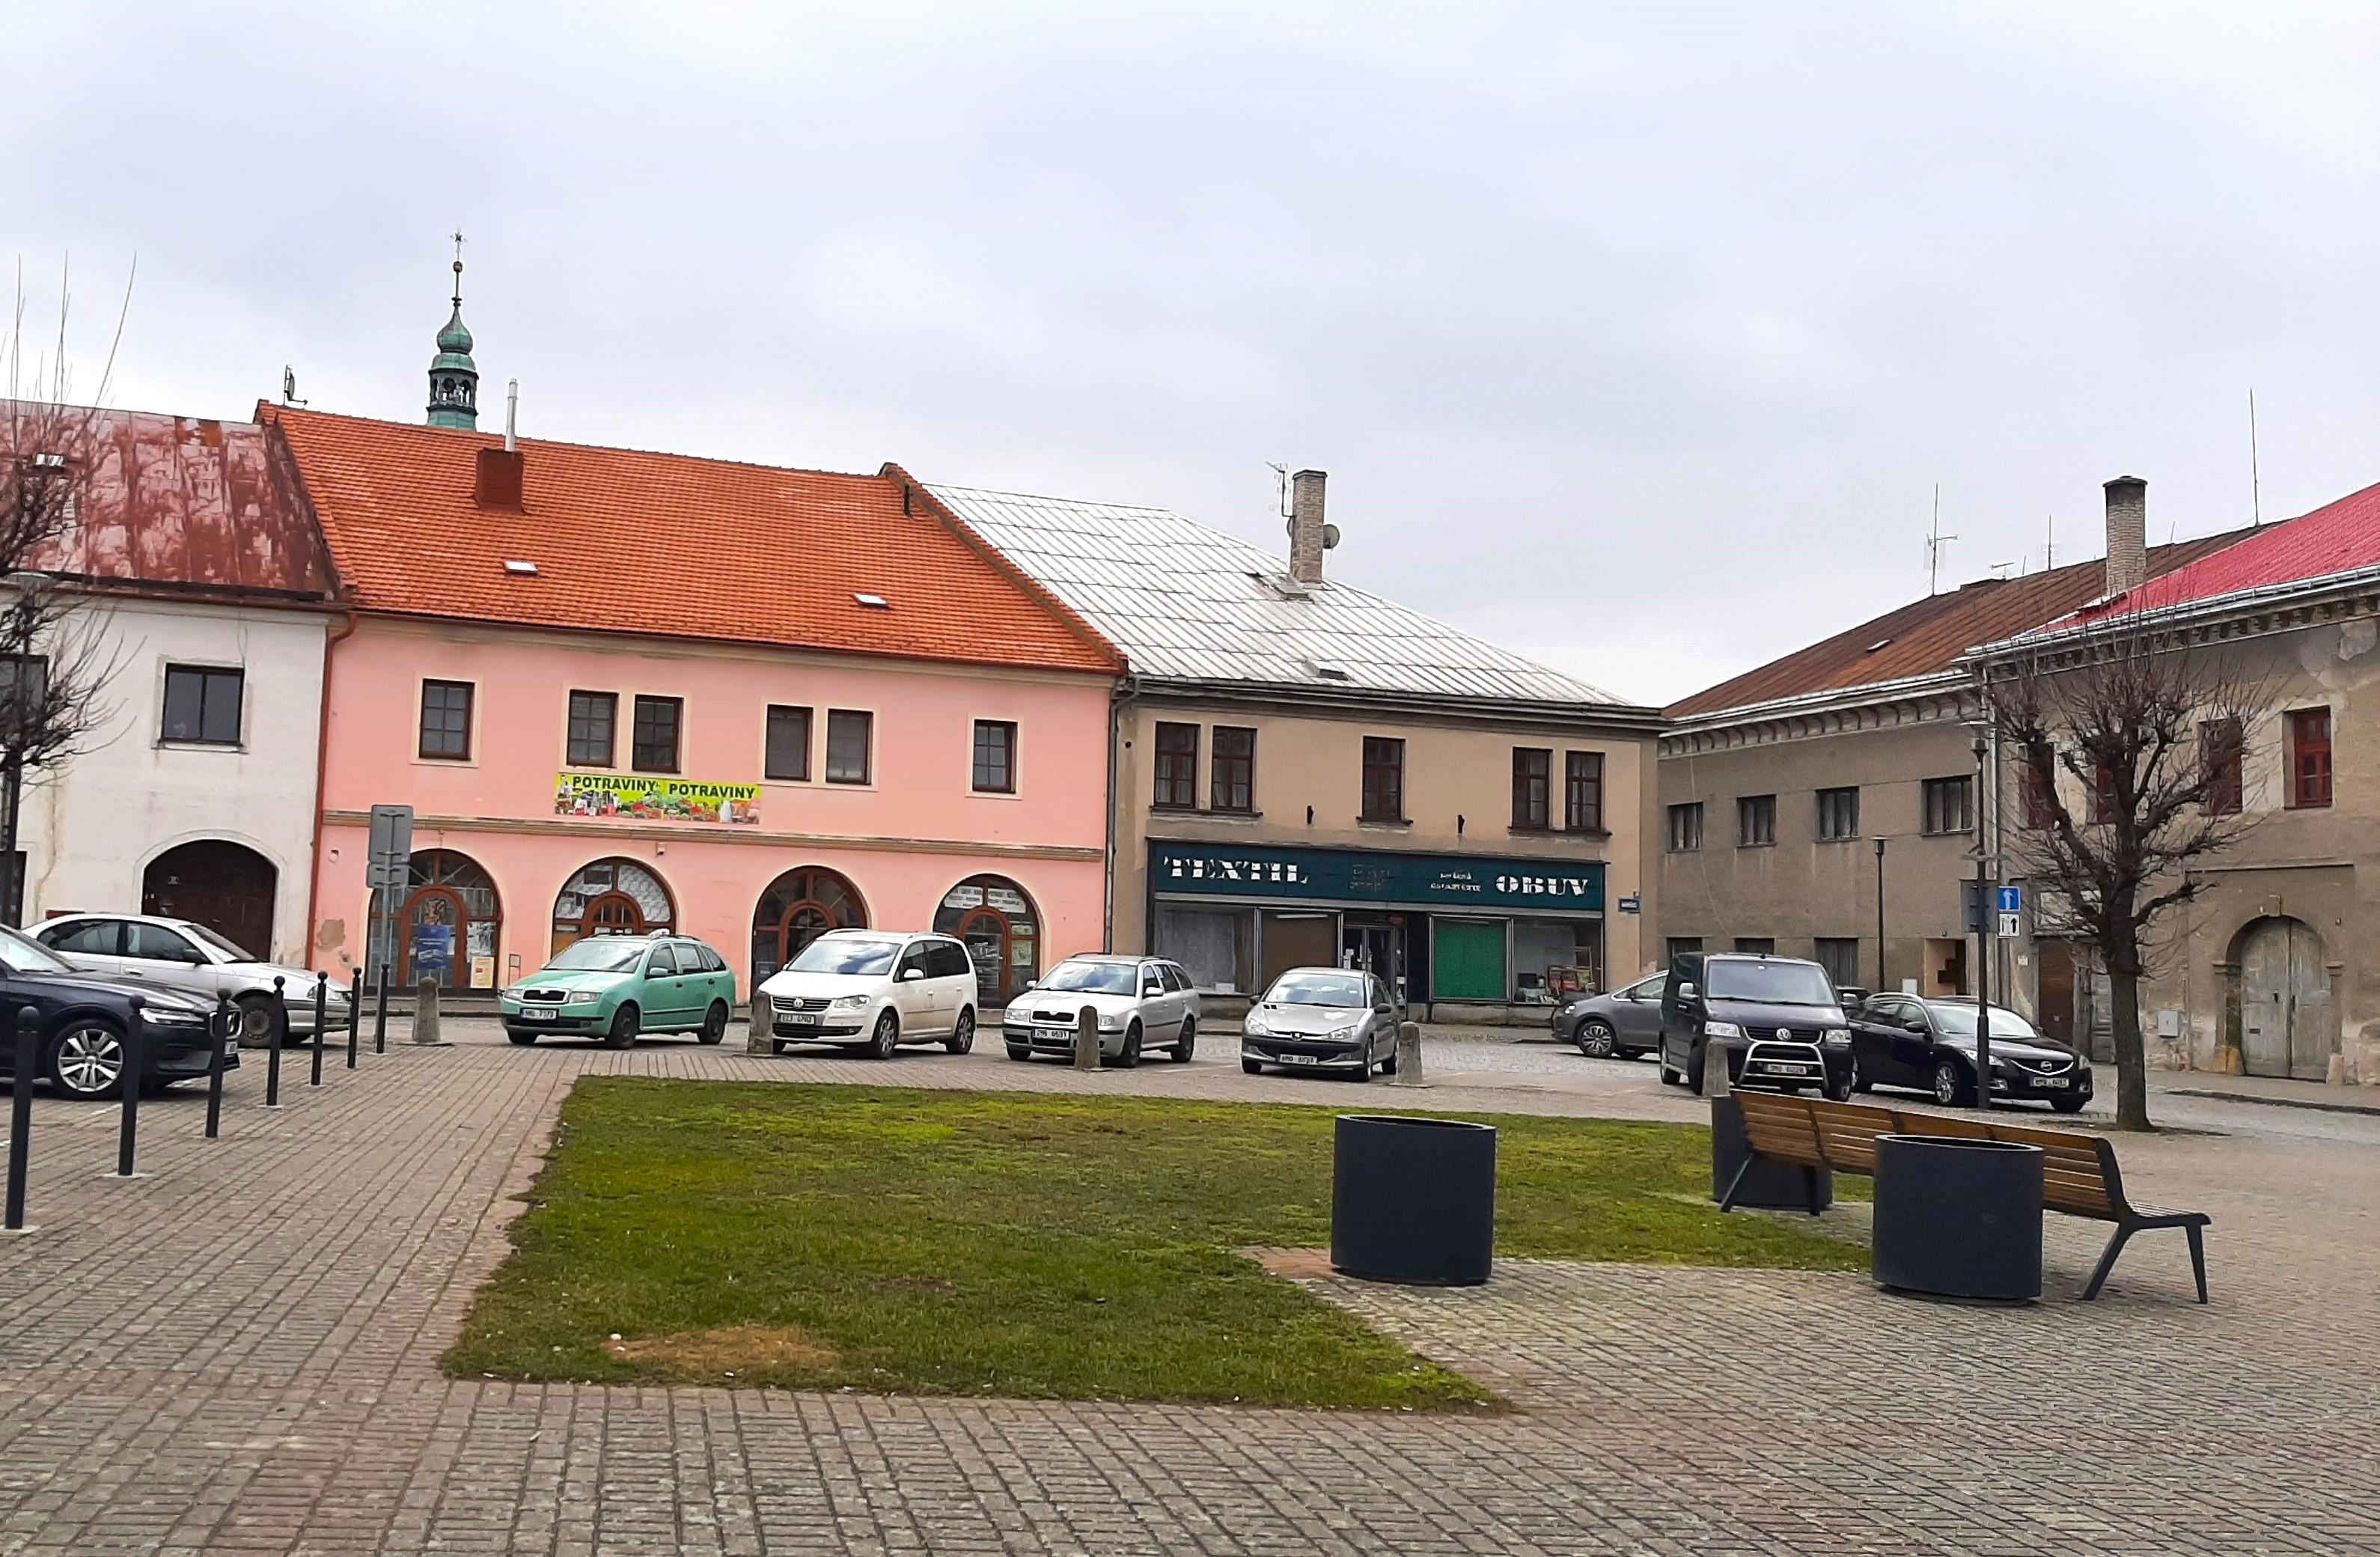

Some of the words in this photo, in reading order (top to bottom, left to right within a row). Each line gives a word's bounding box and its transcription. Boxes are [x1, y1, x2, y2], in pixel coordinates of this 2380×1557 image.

[573, 776, 656, 792] POTRAVINY
[668, 783, 755, 799] POTRAVINY
[1163, 856, 1309, 885] TEXTIL
[1495, 874, 1589, 897] OBUV
